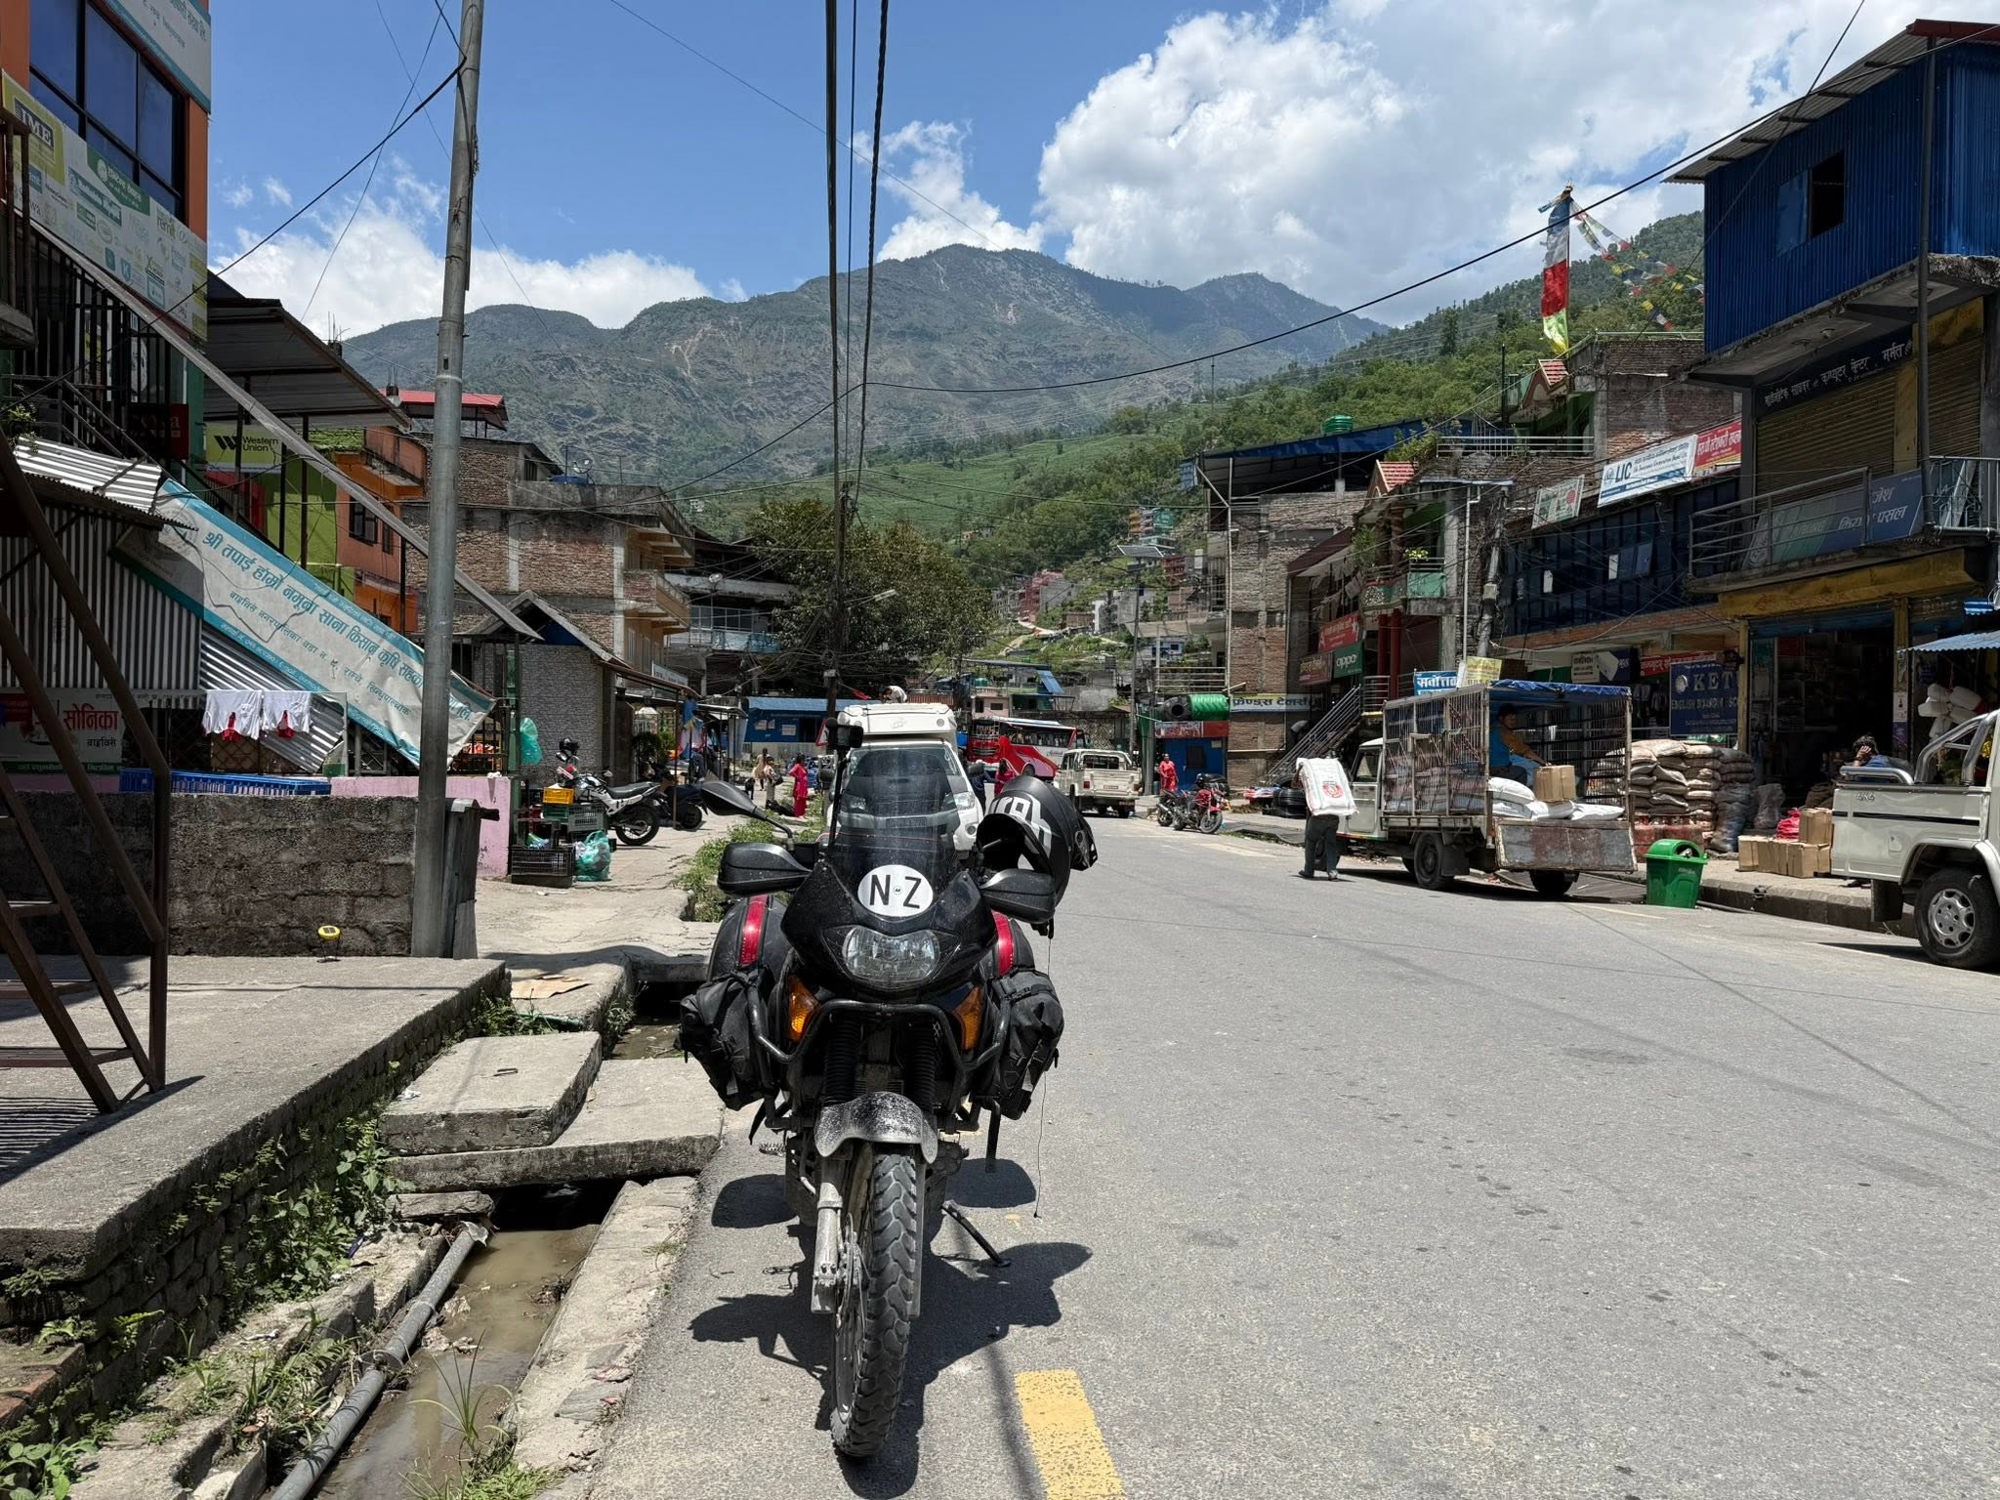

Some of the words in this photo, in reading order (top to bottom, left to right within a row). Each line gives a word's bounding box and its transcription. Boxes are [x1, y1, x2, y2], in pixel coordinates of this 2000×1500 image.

[243, 434, 278, 445] Western
[243, 444, 269, 452] Union
[1614, 461, 1632, 483] LIC
[202, 532, 224, 550] श्री
[318, 608, 350, 635] साना
[347, 625, 380, 656] किसान
[400, 662, 424, 690] सहका
[63, 703, 120, 731] सोनिका
